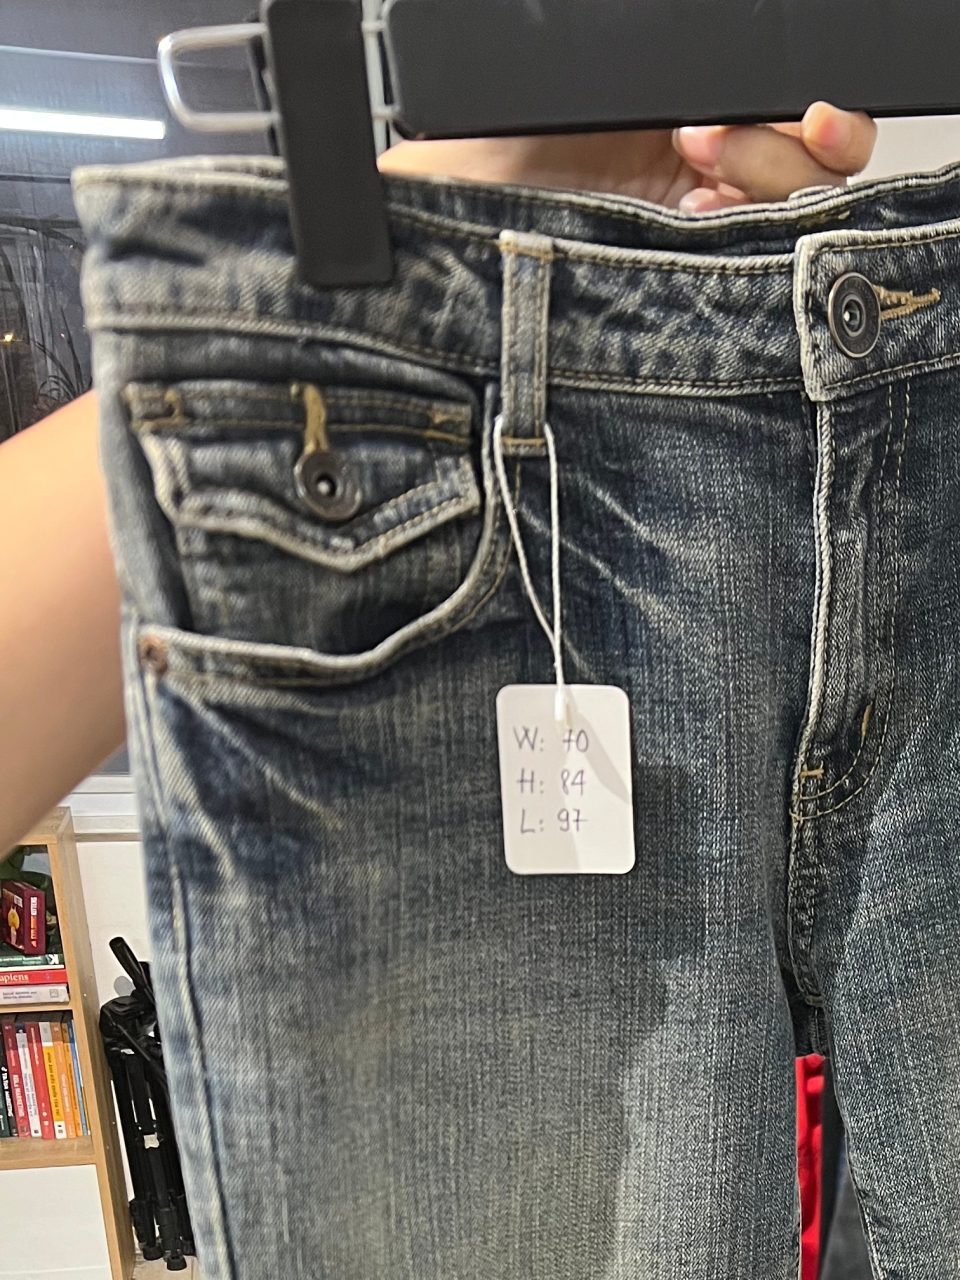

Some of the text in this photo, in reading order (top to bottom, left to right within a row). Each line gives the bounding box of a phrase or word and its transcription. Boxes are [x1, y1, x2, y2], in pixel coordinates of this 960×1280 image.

[513, 725, 544, 752] W:
[516, 768, 586, 796] H: 84
[520, 808, 588, 833] L: 97
